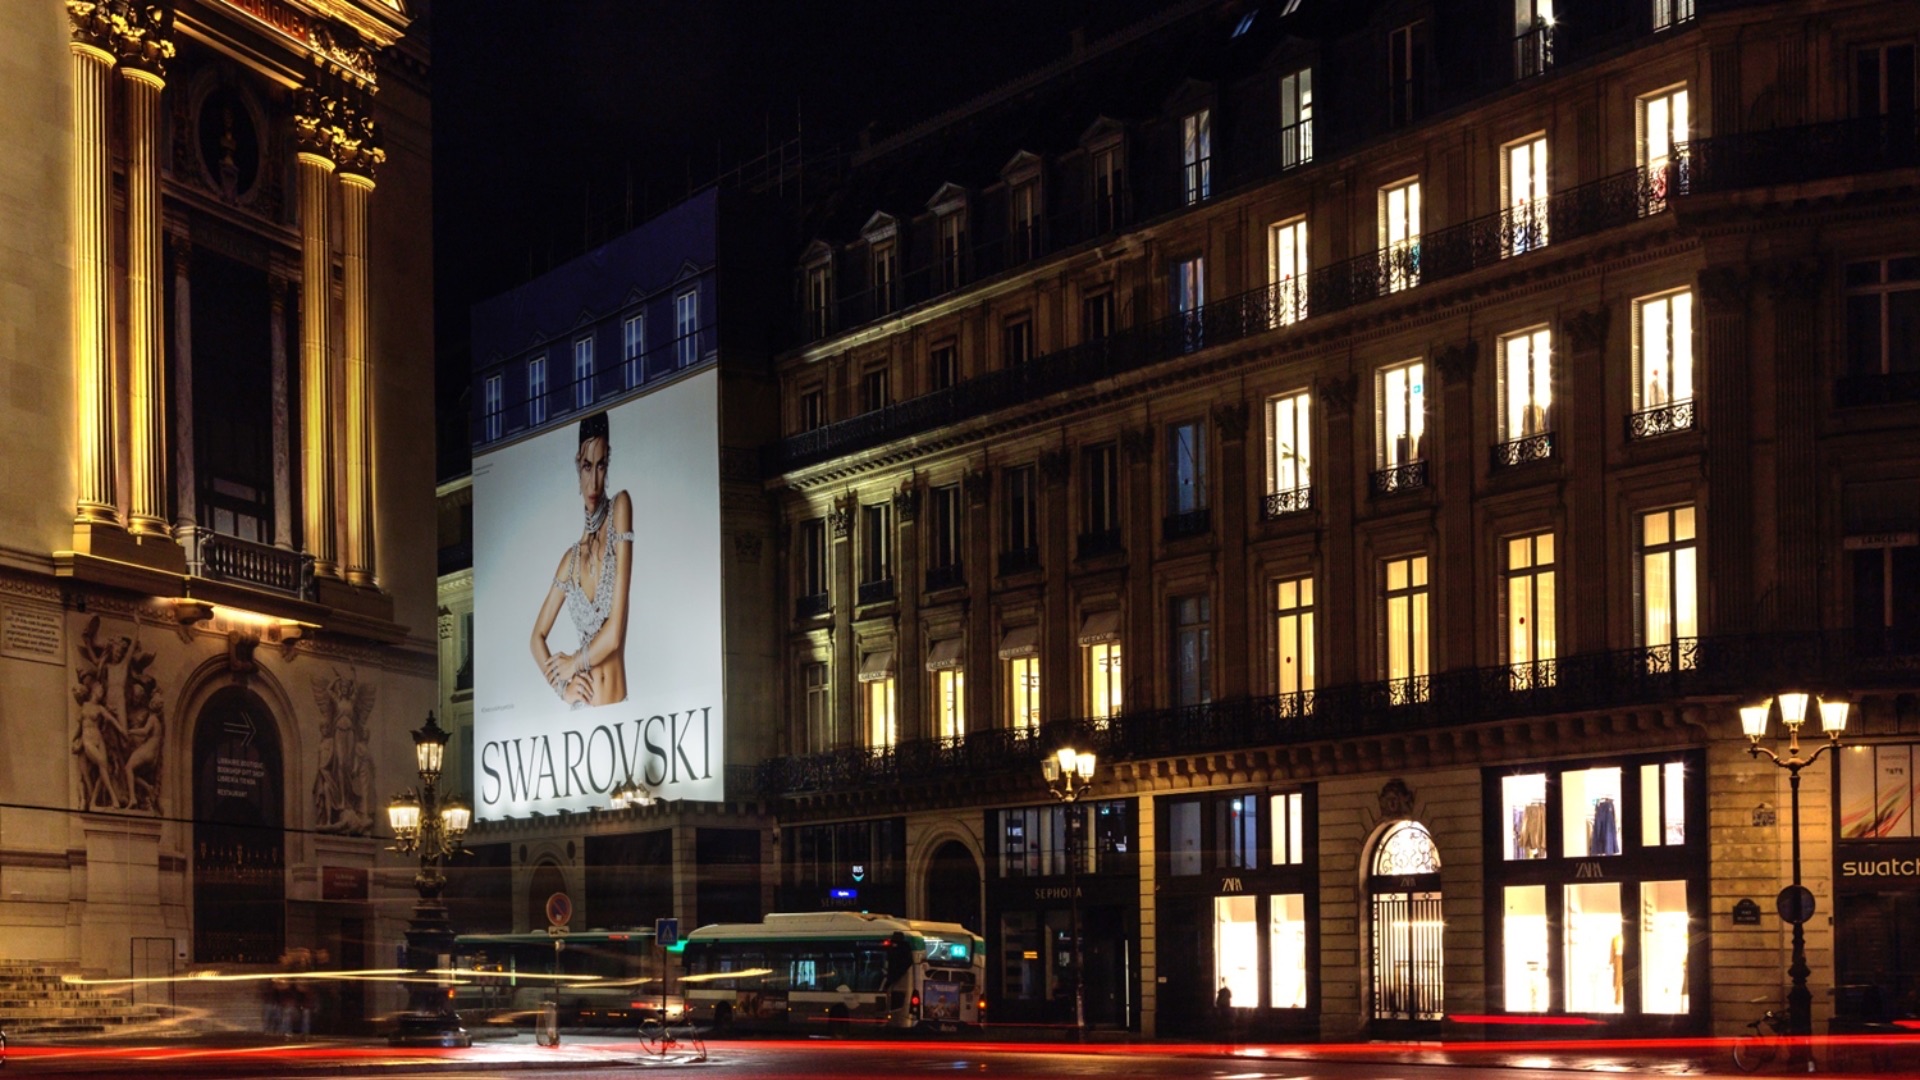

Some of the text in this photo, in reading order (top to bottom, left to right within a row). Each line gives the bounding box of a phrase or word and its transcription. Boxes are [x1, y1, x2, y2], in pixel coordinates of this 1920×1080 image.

[481, 707, 713, 805] SWAROVSKI
[852, 865, 864, 873] BUS
[1575, 862, 1604, 878] ZARA
[1842, 858, 1920, 877] swatc
[1221, 877, 1243, 892] ZARA
